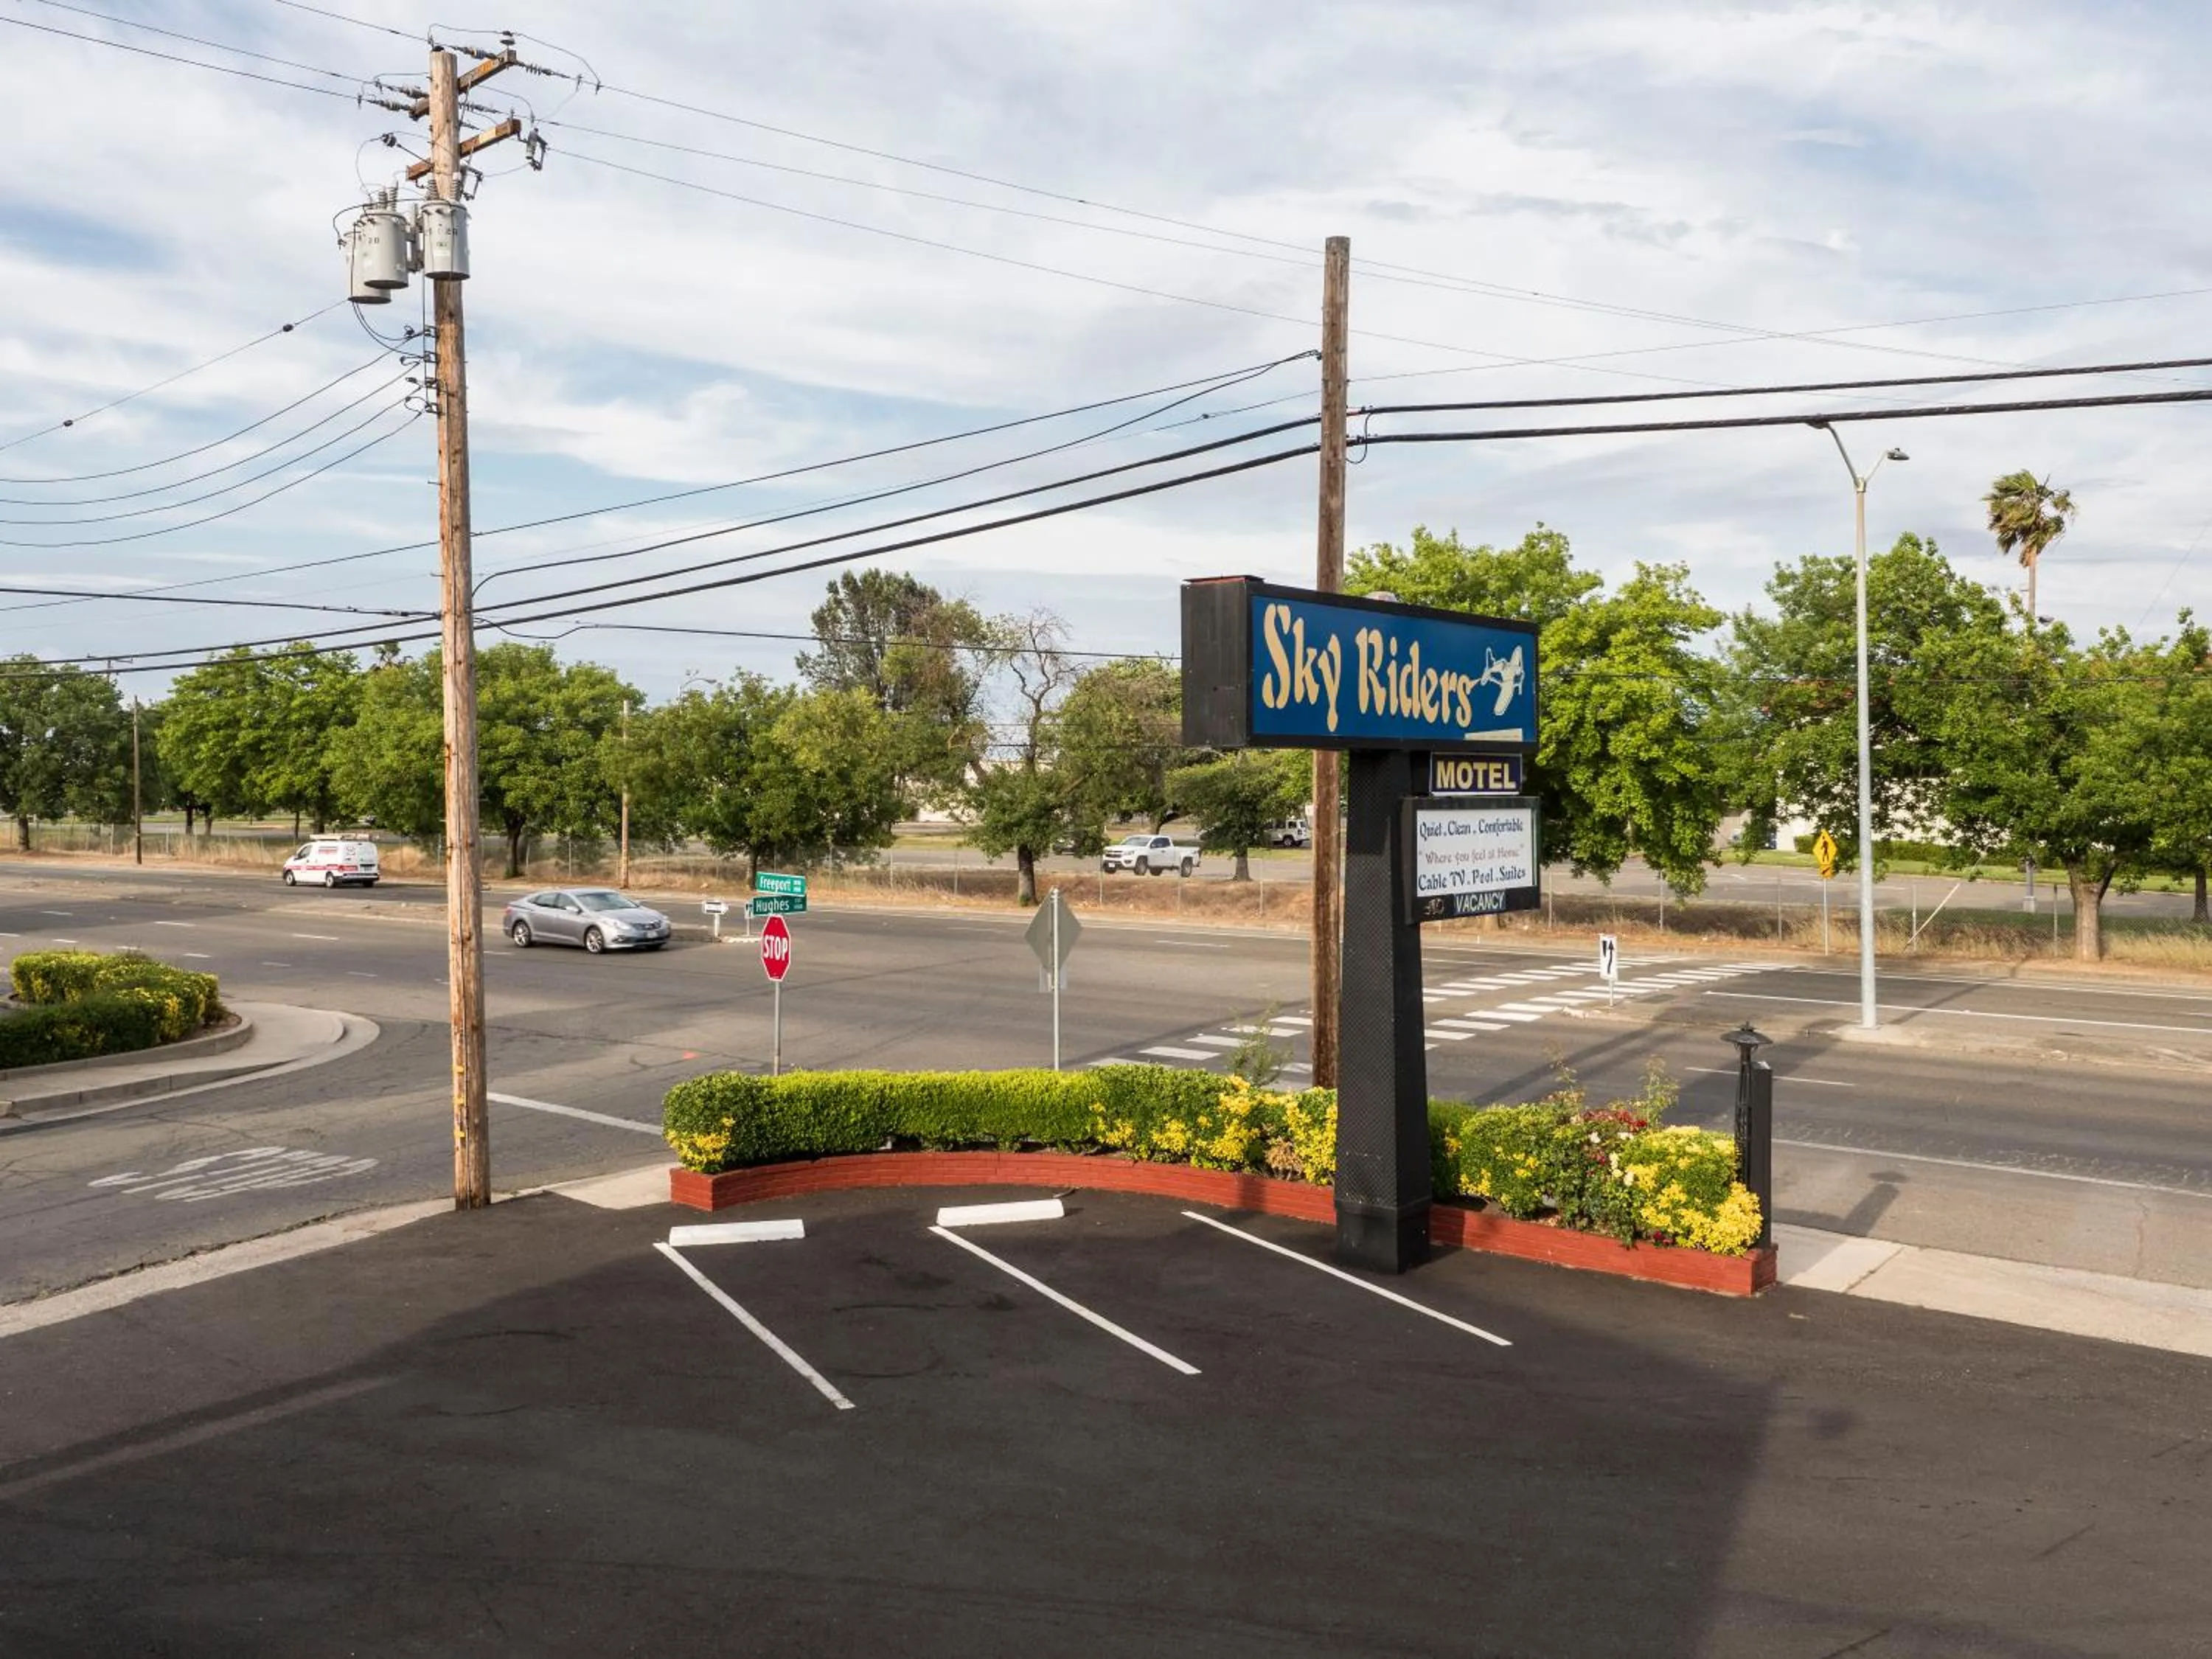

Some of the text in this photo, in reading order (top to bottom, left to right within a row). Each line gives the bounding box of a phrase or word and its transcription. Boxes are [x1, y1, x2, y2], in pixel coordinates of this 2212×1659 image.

[1262, 602, 1473, 732] Sky Riders
[1436, 760, 1517, 790] MOTEL
[1447, 820, 1471, 835] Clean
[1478, 818, 1523, 836] Comfortable
[760, 875, 790, 893] Freeport
[1418, 874, 1447, 891] Cable
[1450, 869, 1465, 886] TV
[756, 898, 790, 914] Hughes
[1455, 892, 1505, 912] VACANCY
[763, 935, 788, 961] STOP
